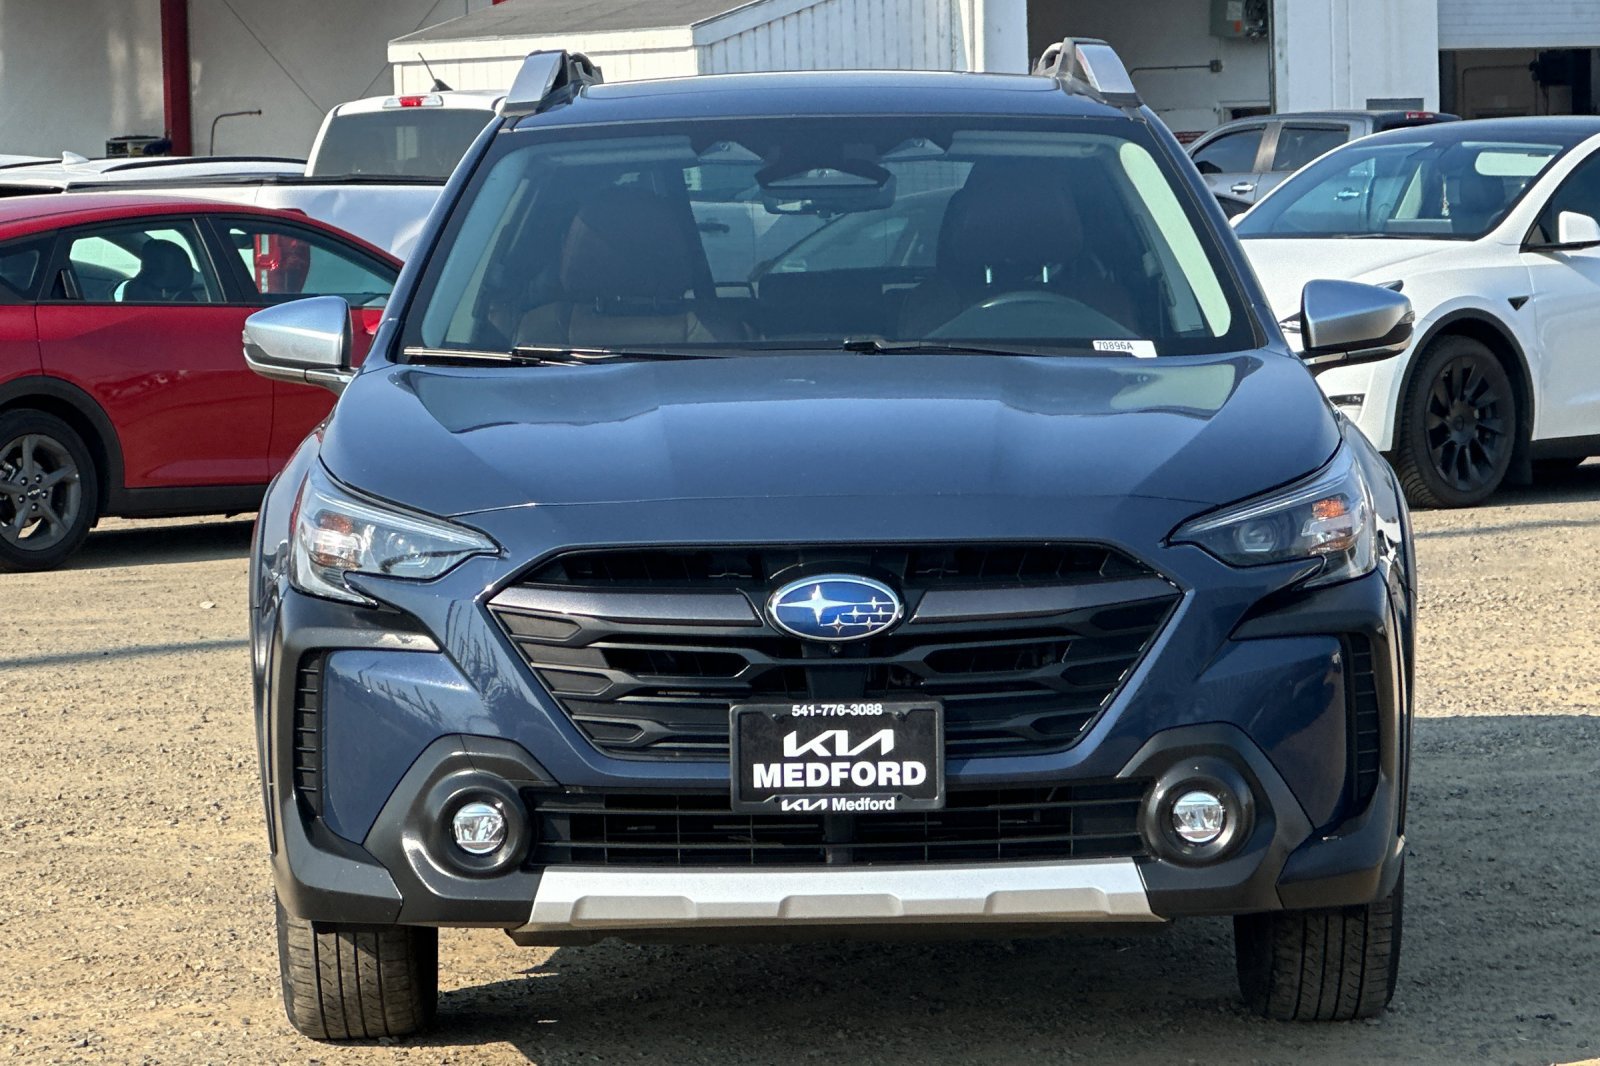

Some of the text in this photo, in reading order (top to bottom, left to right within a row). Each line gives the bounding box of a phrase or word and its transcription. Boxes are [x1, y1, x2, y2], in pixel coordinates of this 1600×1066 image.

[1096, 341, 1134, 351] 70896A
[791, 703, 883, 717] 541-776-3088
[783, 728, 895, 758] KIA
[752, 761, 927, 789] MEDFORD
[781, 797, 895, 811] KIA Medford
